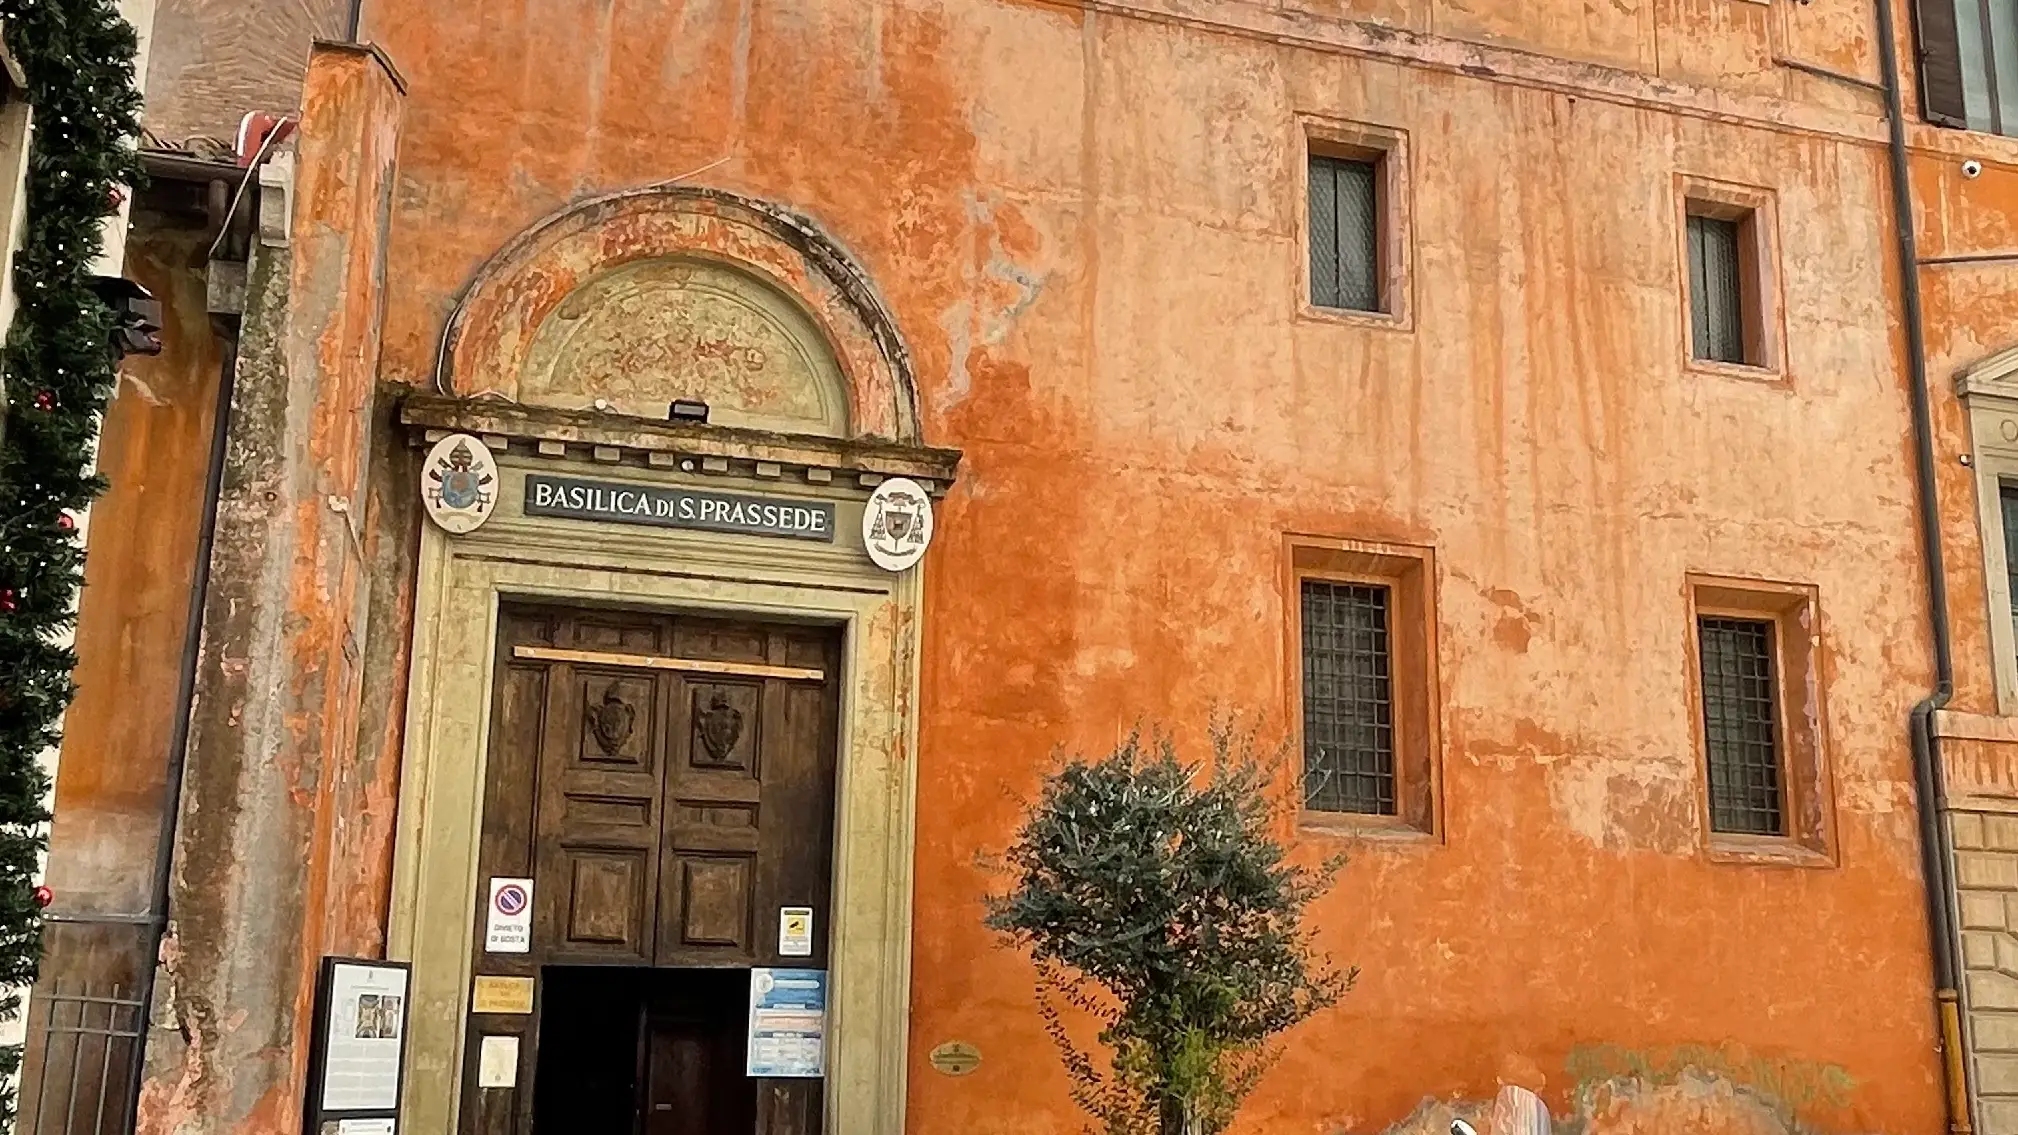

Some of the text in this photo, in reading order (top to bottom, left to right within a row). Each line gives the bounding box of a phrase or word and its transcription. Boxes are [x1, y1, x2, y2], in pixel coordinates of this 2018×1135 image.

[535, 483, 652, 515] BASILICA
[655, 499, 674, 517] DI
[700, 499, 826, 531] PRASSEDE
